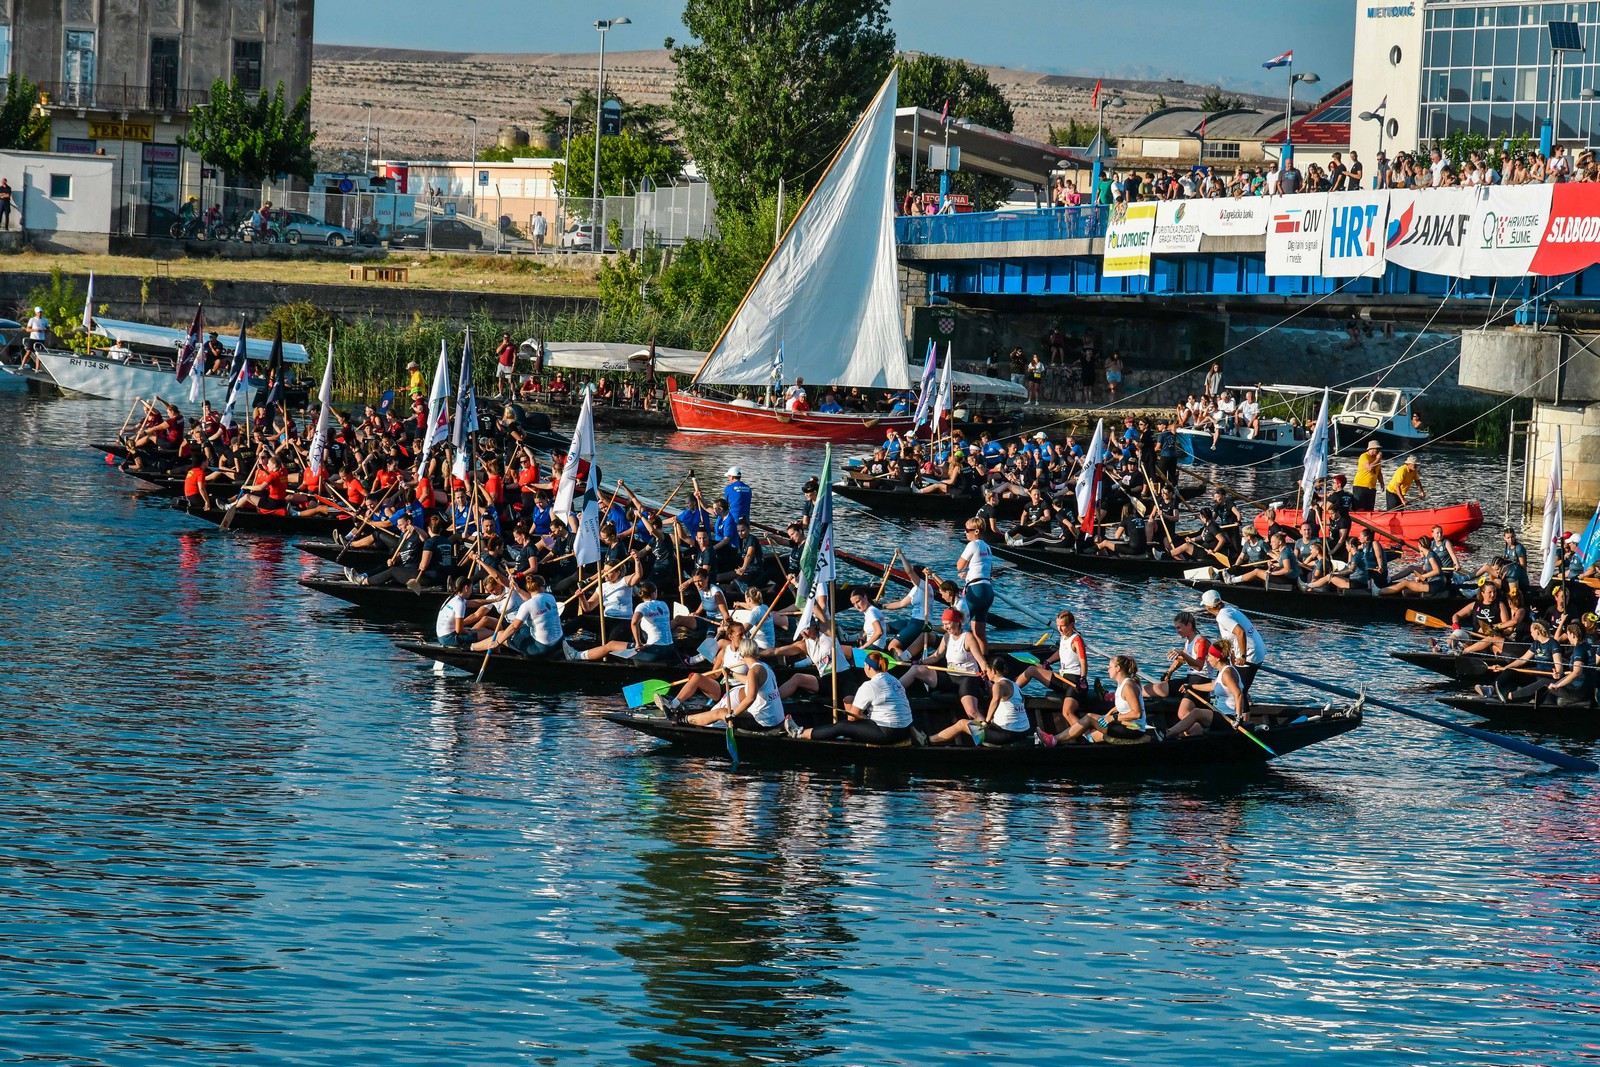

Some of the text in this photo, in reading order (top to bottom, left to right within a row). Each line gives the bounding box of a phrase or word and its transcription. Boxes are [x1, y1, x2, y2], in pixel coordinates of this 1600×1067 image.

[92, 124, 150, 139] TERMIN
[1243, 209, 1254, 219] banka
[1303, 209, 1322, 233] OIV
[1507, 214, 1539, 227] HRVATSKE
[1330, 204, 1379, 258] HRT
[1399, 214, 1471, 247] JANAF
[1510, 228, 1531, 244] ŠUME
[1546, 216, 1600, 243] SLOBOD
[69, 358, 110, 371] RH 134 SK
